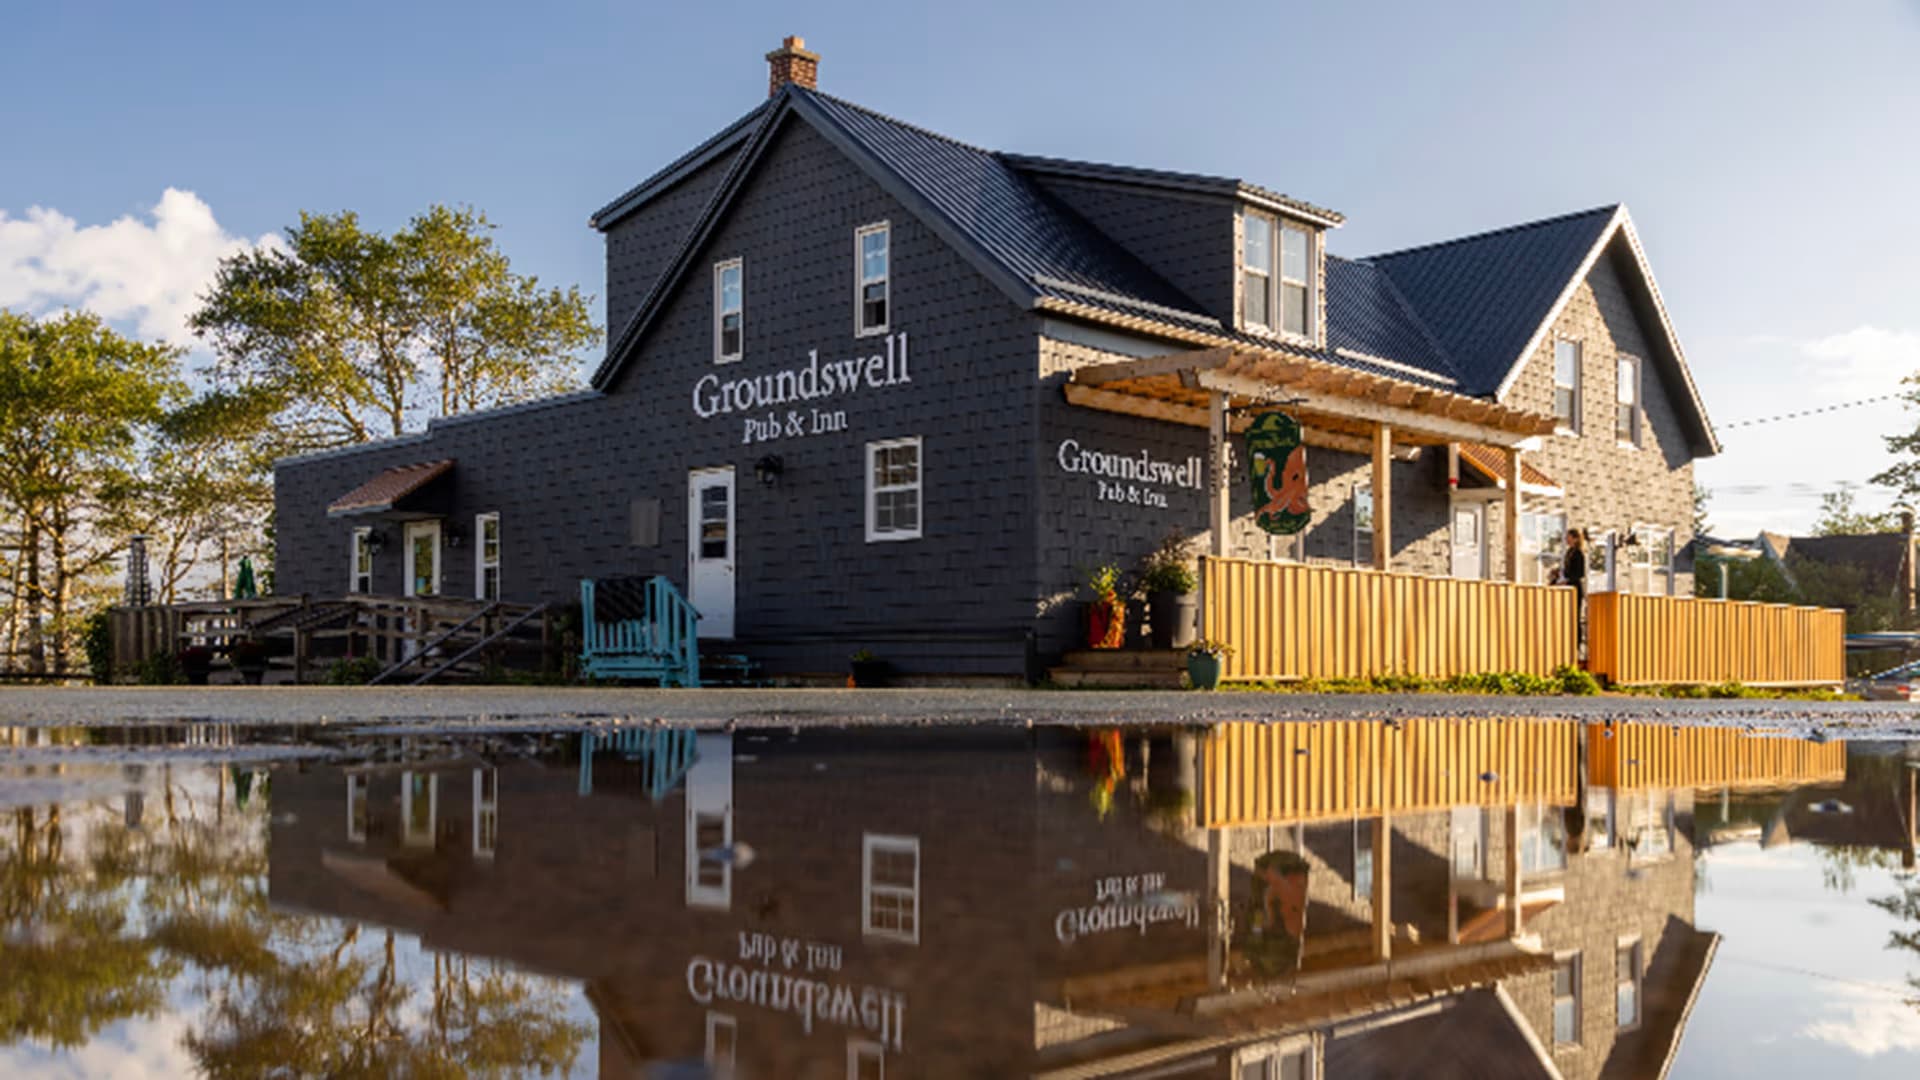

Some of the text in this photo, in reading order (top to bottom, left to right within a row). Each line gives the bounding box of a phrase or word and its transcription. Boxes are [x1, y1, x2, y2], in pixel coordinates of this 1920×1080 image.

[692, 332, 911, 418] Groundswell
[742, 408, 848, 443] Pub & Inn
[1058, 439, 1202, 489] Groundswell
[1098, 480, 1125, 502] Pub
